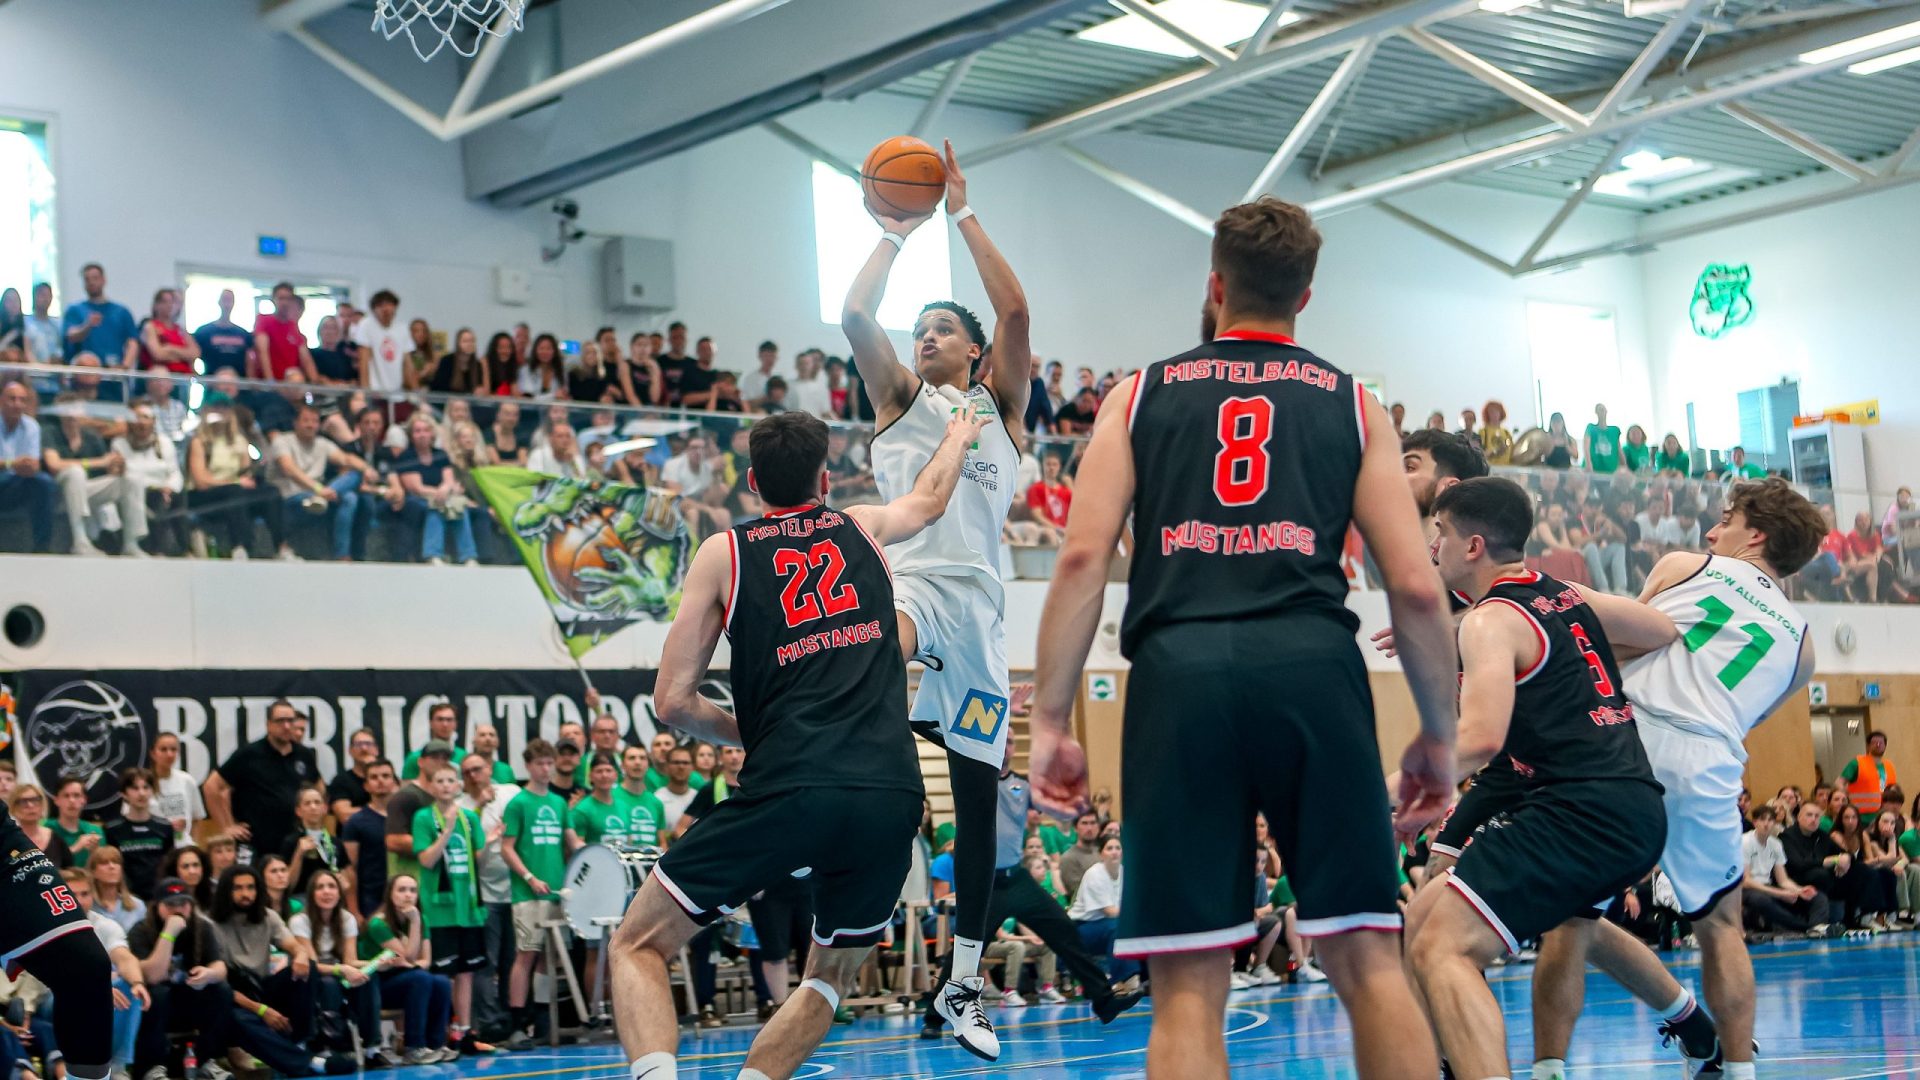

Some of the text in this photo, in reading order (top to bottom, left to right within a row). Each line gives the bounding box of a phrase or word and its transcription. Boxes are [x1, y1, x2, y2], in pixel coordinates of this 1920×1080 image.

[1163, 358, 1339, 392] MISTELBACH
[1213, 395, 1275, 507] 8
[1161, 520, 1316, 556] MUSTANGS
[772, 538, 860, 628] 22
[1735, 586, 1800, 642] ALLIGATORS
[776, 619, 882, 667] MUSTANGS
[1683, 594, 1776, 692] 11
[41, 885, 77, 915] 15
